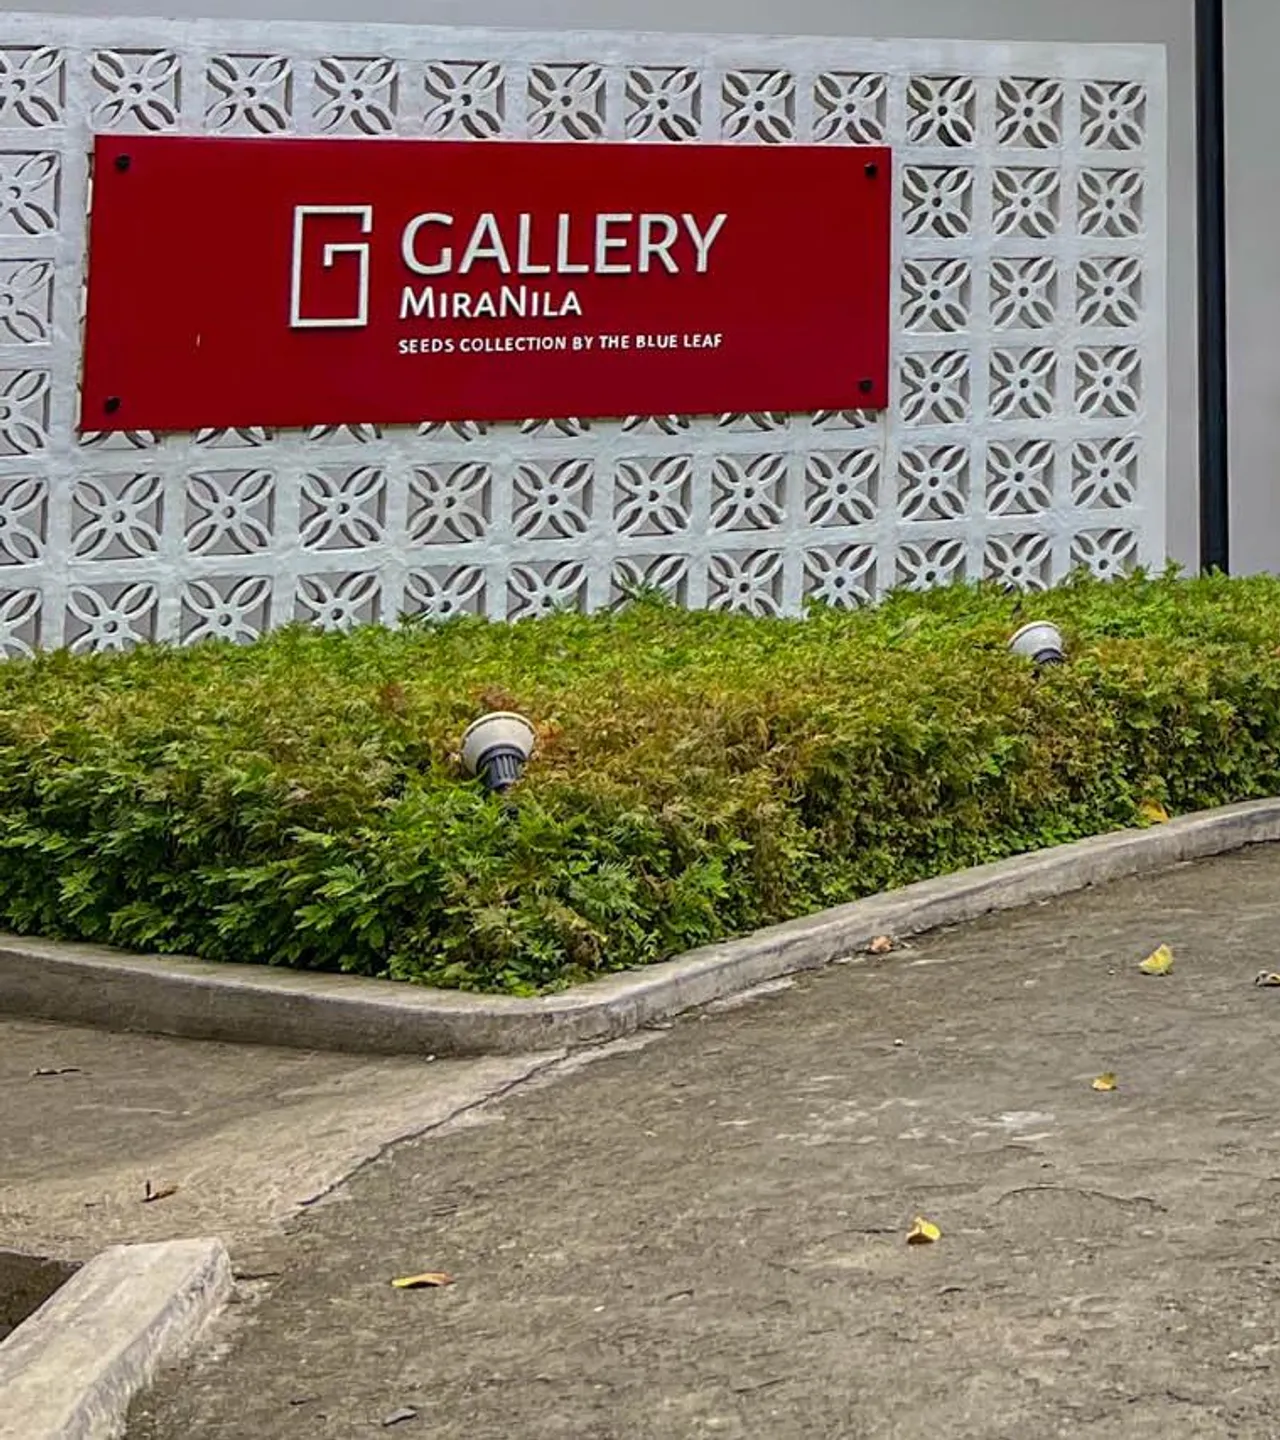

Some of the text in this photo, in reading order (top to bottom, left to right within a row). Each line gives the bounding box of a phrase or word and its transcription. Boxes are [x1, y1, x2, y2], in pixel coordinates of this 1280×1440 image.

[402, 212, 728, 276] GALLERY
[398, 333, 723, 354] SEEDS COLLECTION BY THE BLUE LEAF
